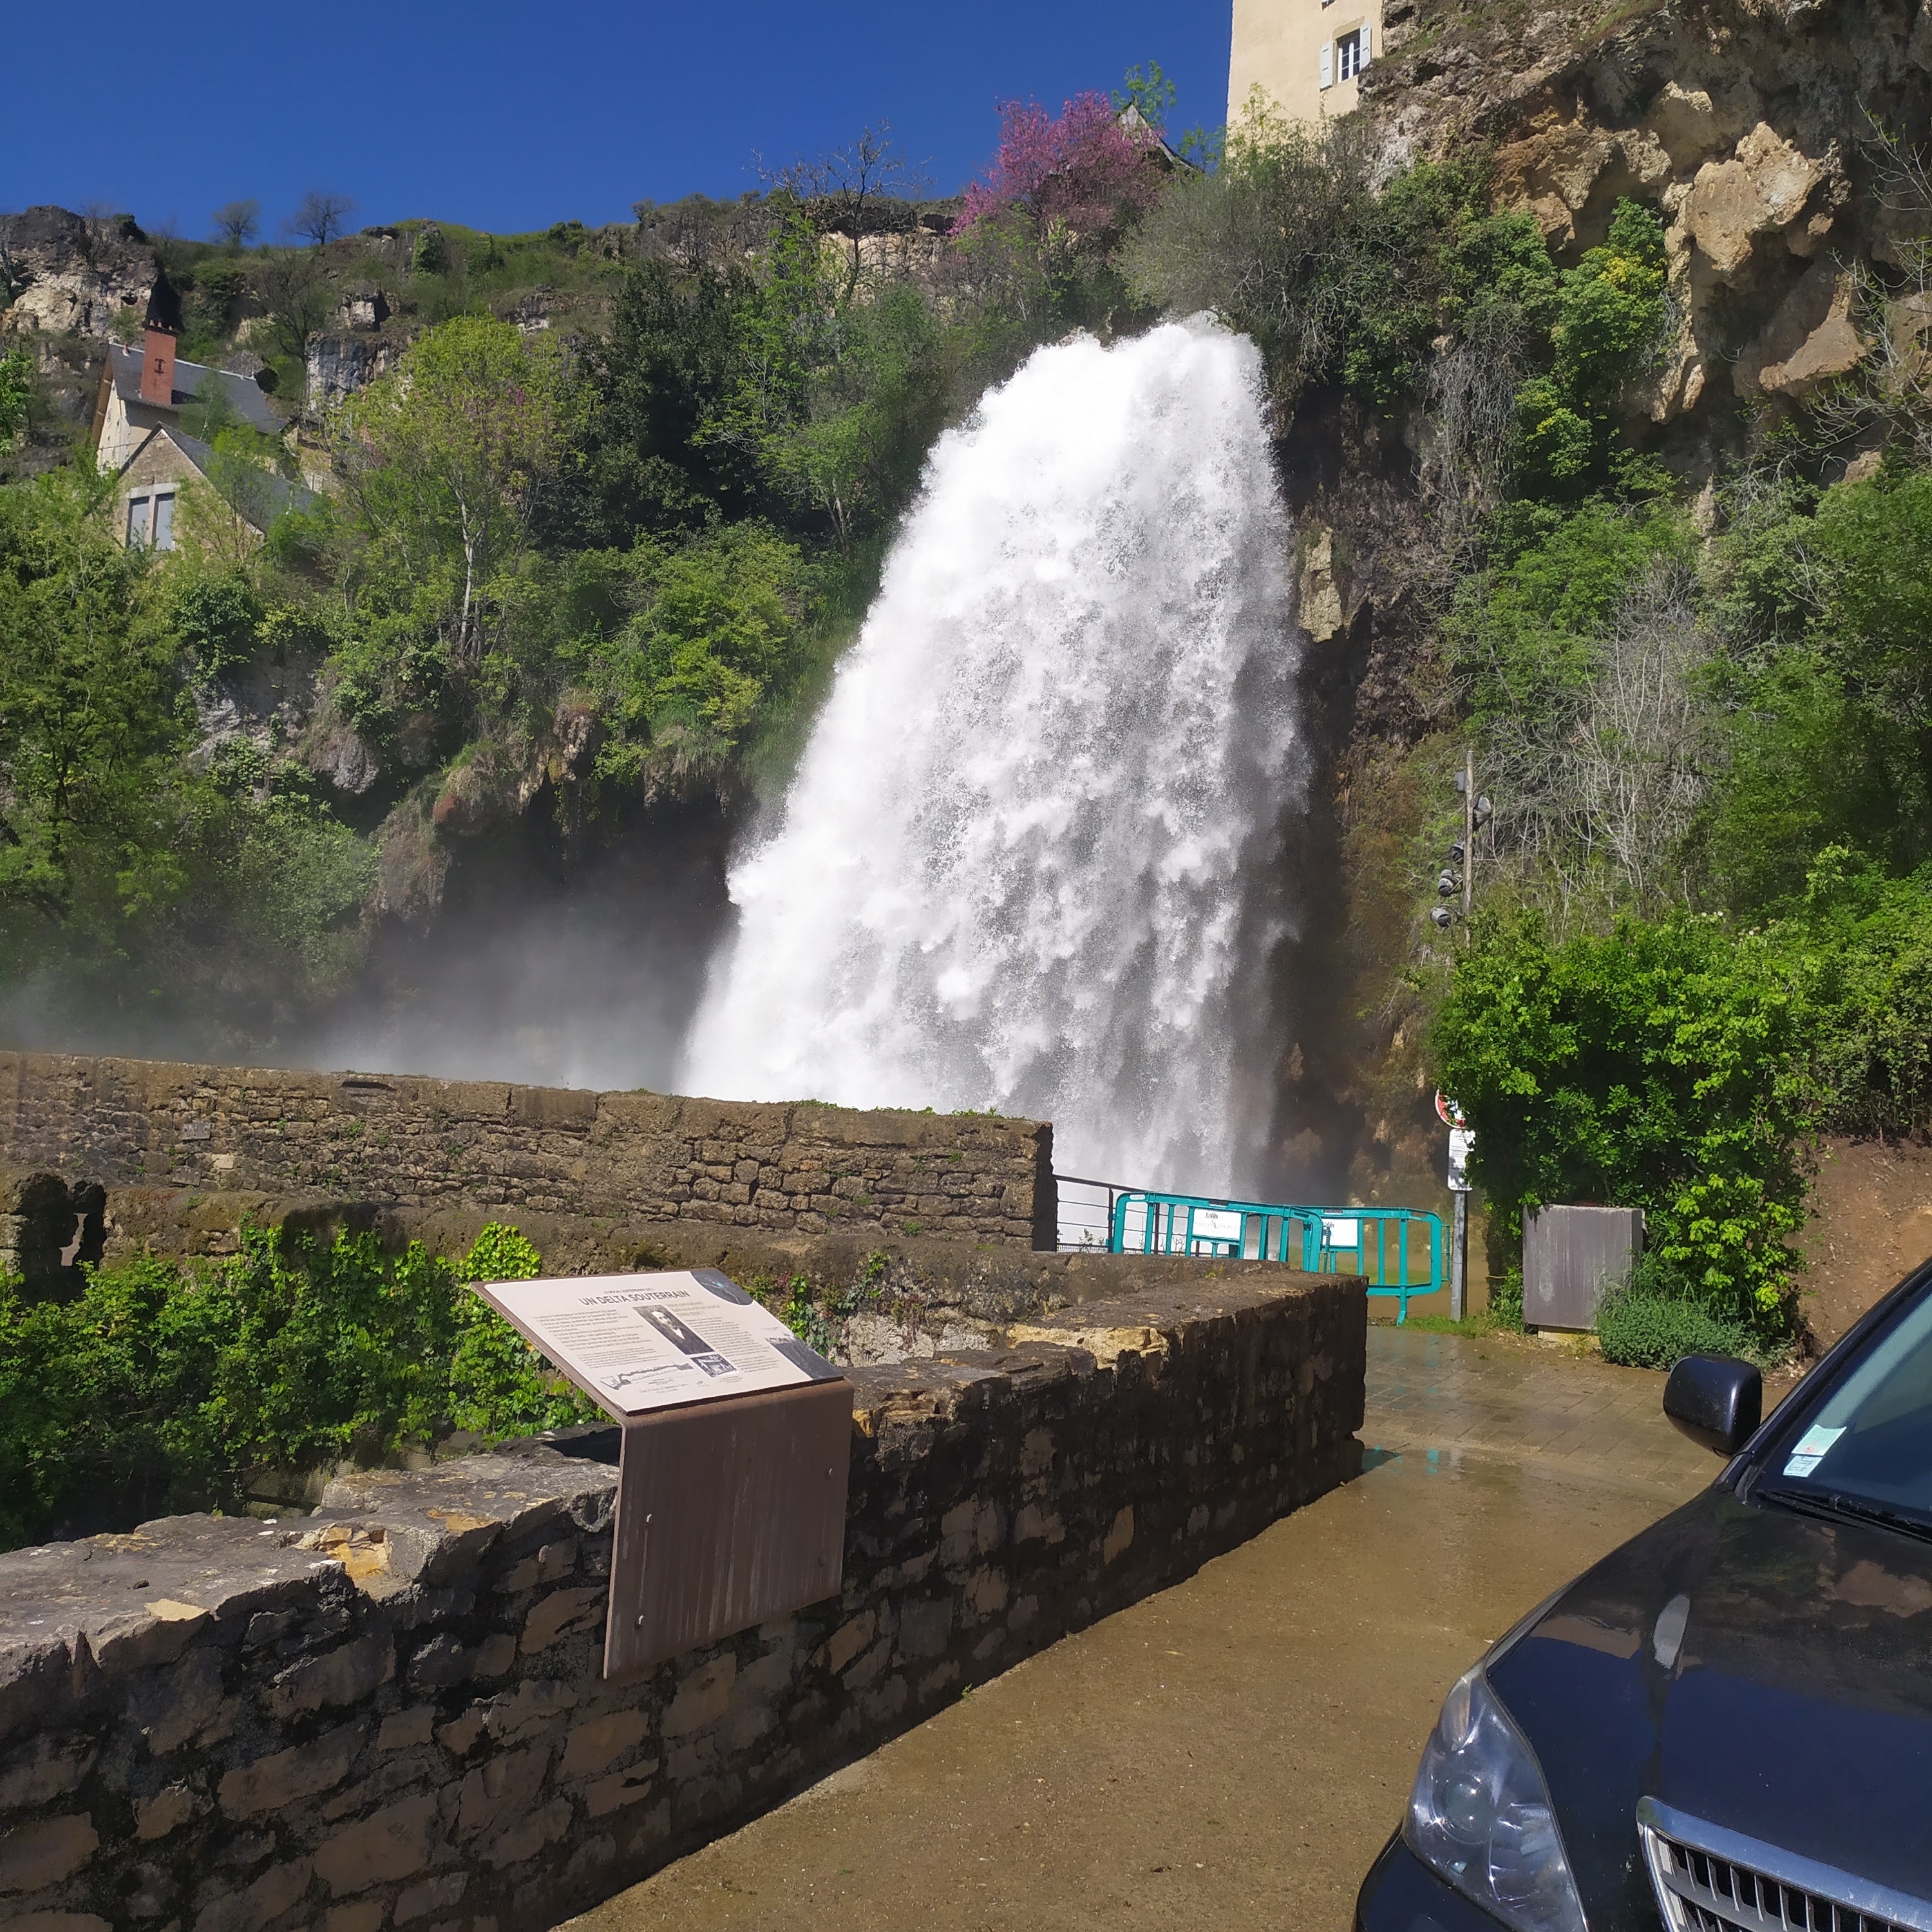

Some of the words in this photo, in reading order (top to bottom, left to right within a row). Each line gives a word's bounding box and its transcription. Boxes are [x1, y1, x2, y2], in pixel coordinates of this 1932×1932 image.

[578, 1296, 598, 1305] UN
[596, 1294, 631, 1304] DELTA
[629, 1289, 691, 1302] SOUTERRAIN
